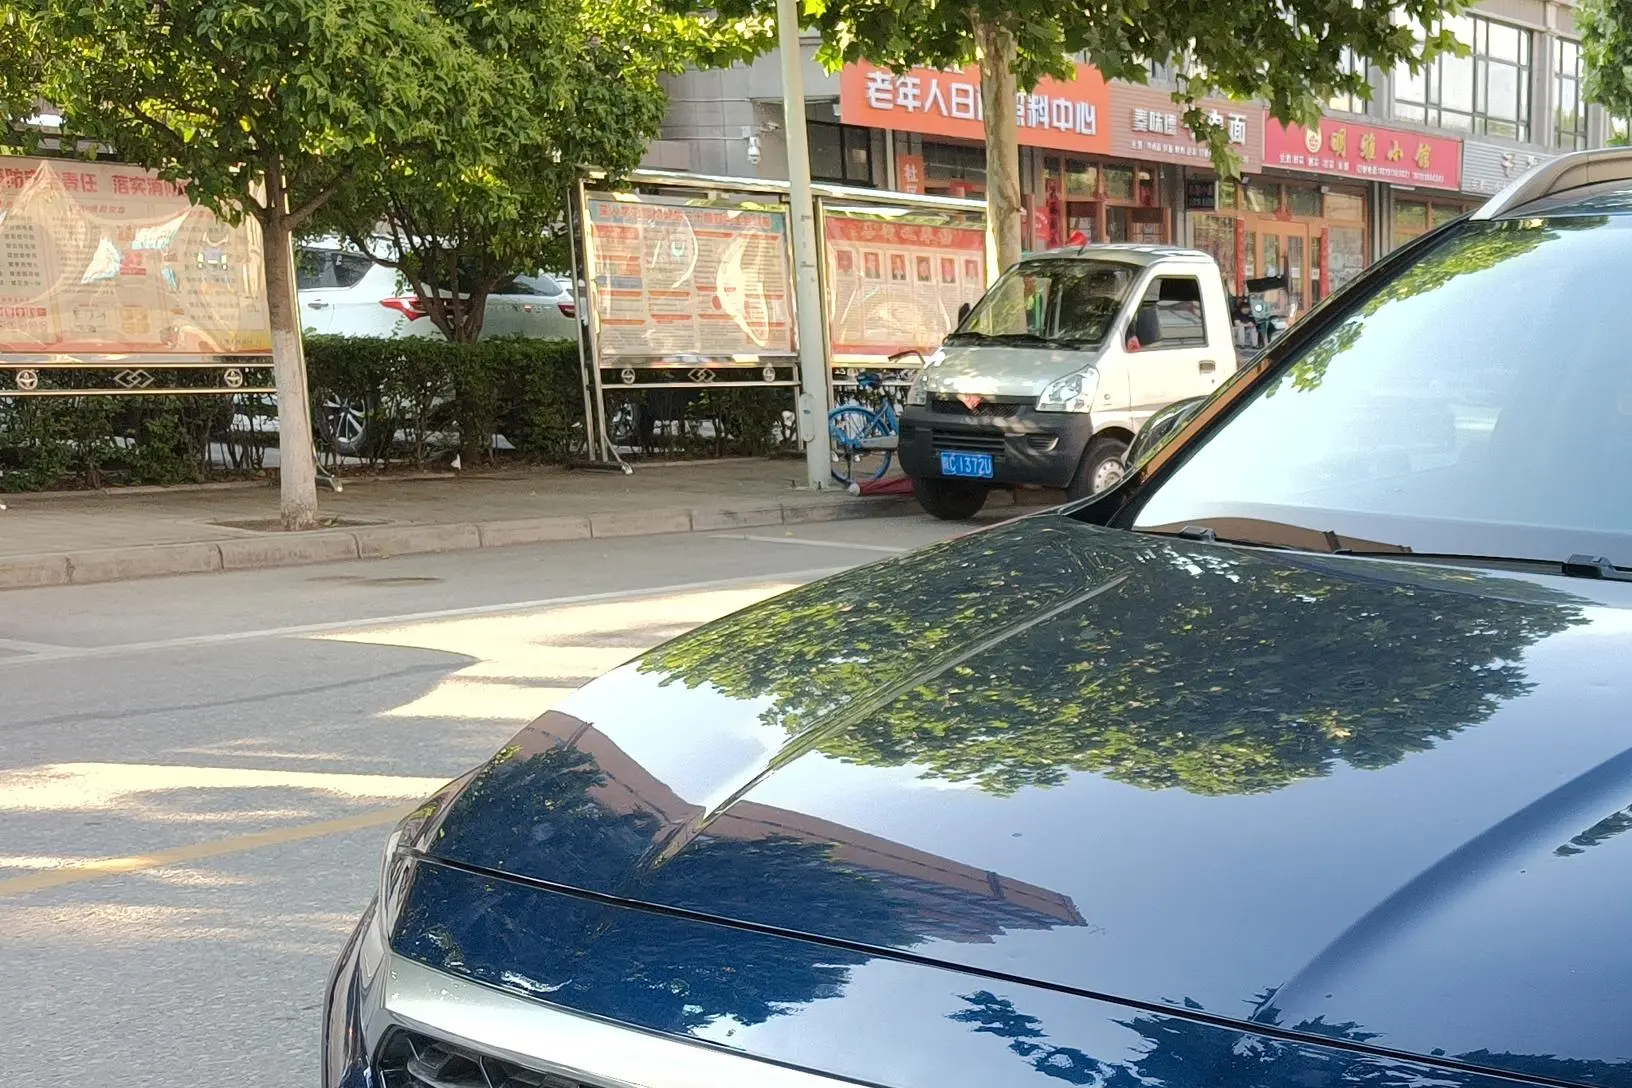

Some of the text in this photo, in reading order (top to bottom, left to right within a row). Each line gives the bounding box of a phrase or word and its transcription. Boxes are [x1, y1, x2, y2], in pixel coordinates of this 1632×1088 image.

[866, 71, 1096, 135] 老年人日料中心
